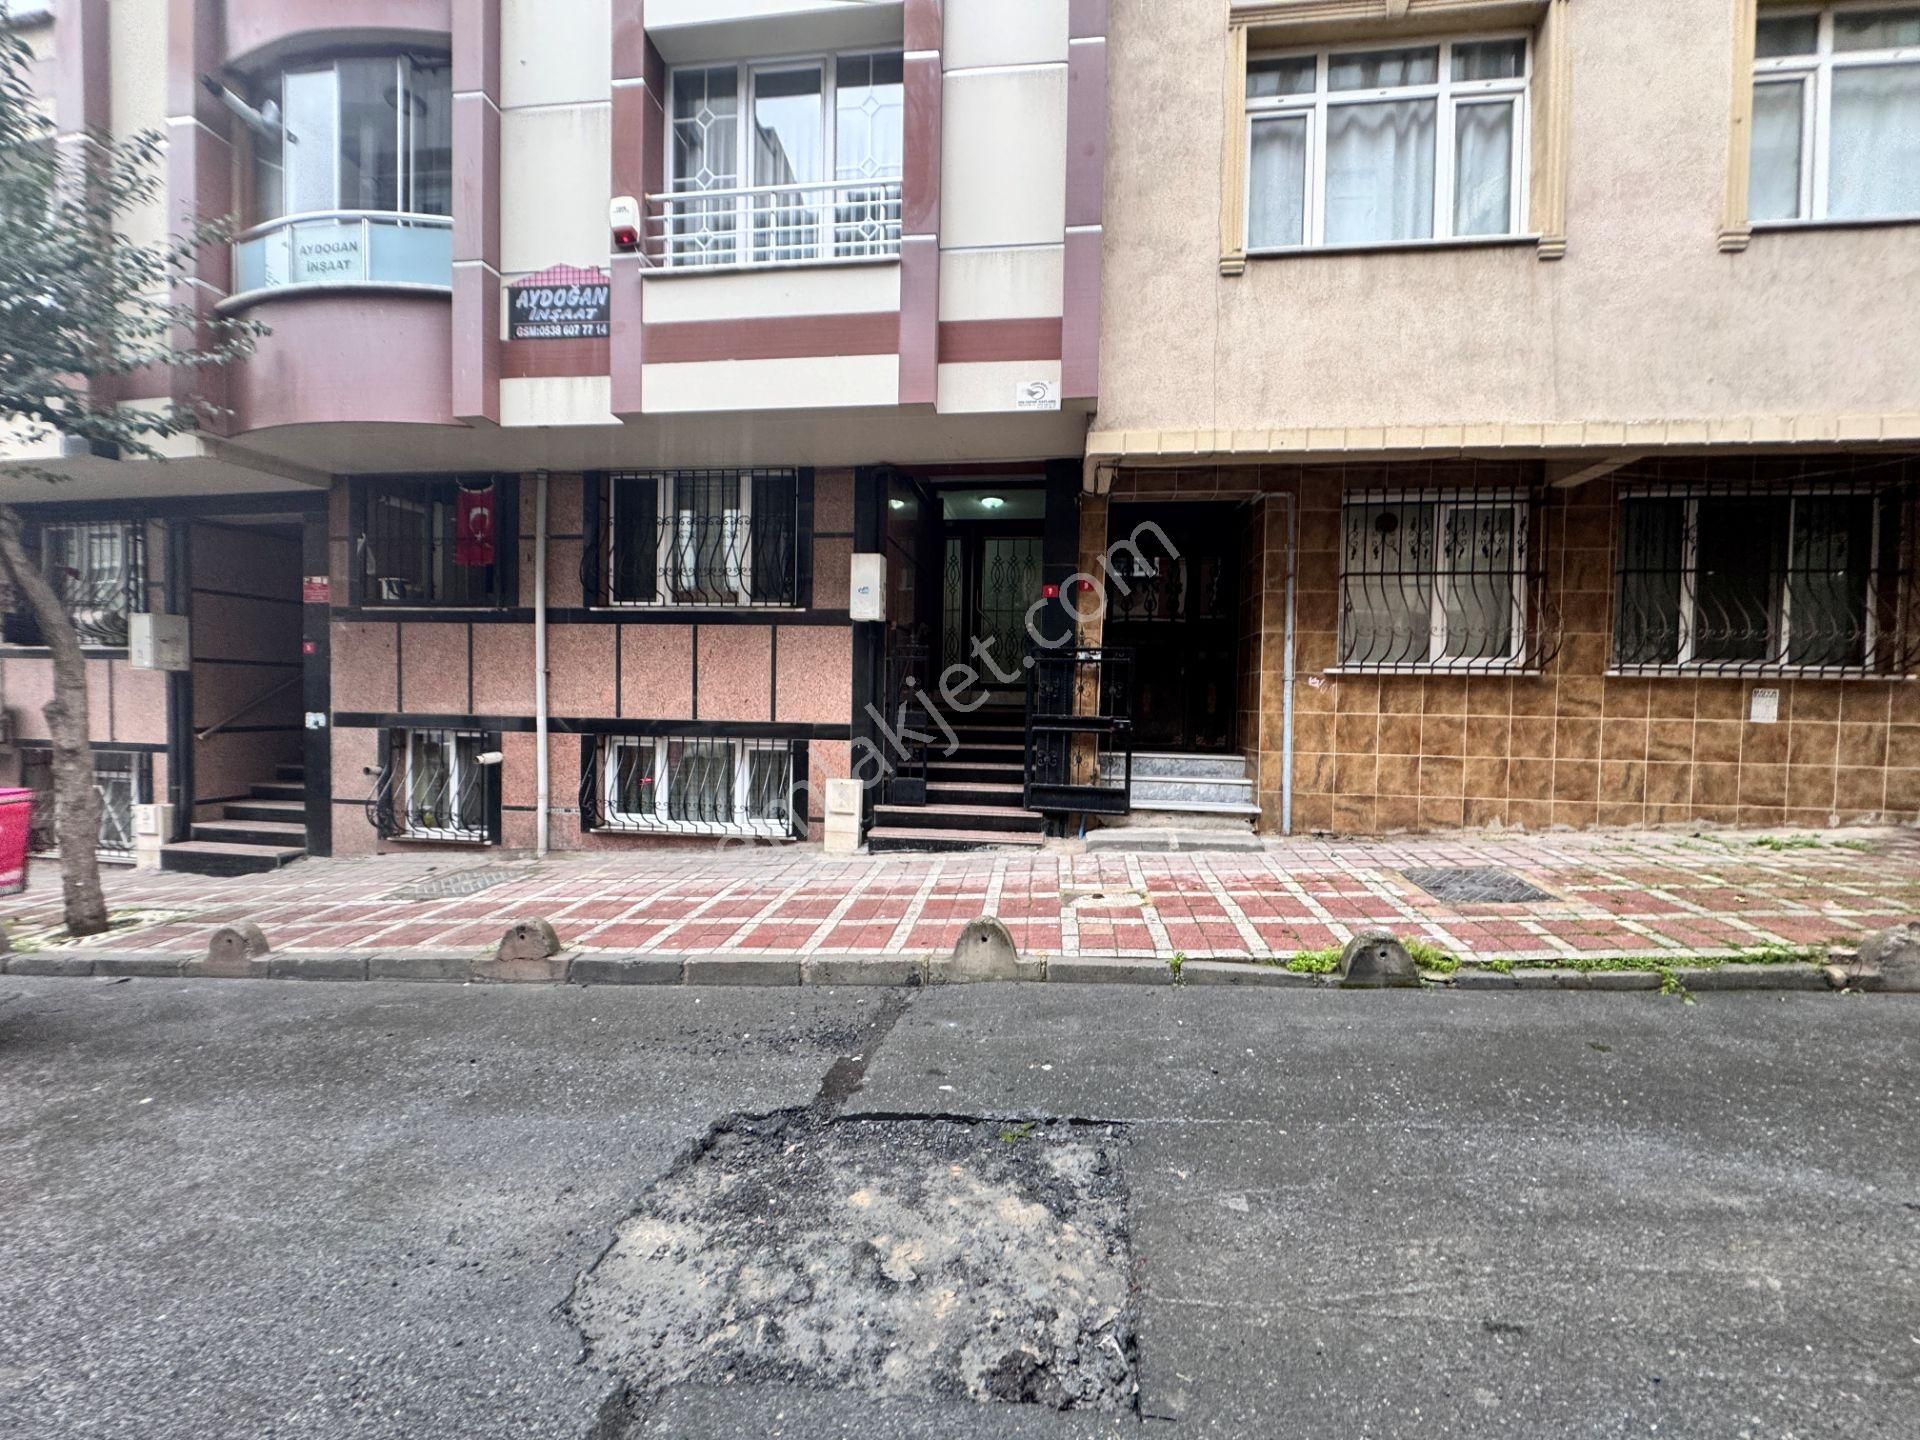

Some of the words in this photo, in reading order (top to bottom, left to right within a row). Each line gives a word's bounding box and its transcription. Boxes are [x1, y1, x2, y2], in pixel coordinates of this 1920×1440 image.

[515, 284, 609, 309] AYDOĞAN
[528, 306, 598, 323] İNŞAAT
[563, 324, 580, 336] 607
[582, 324, 594, 335] 77
[596, 323, 608, 335] 14
